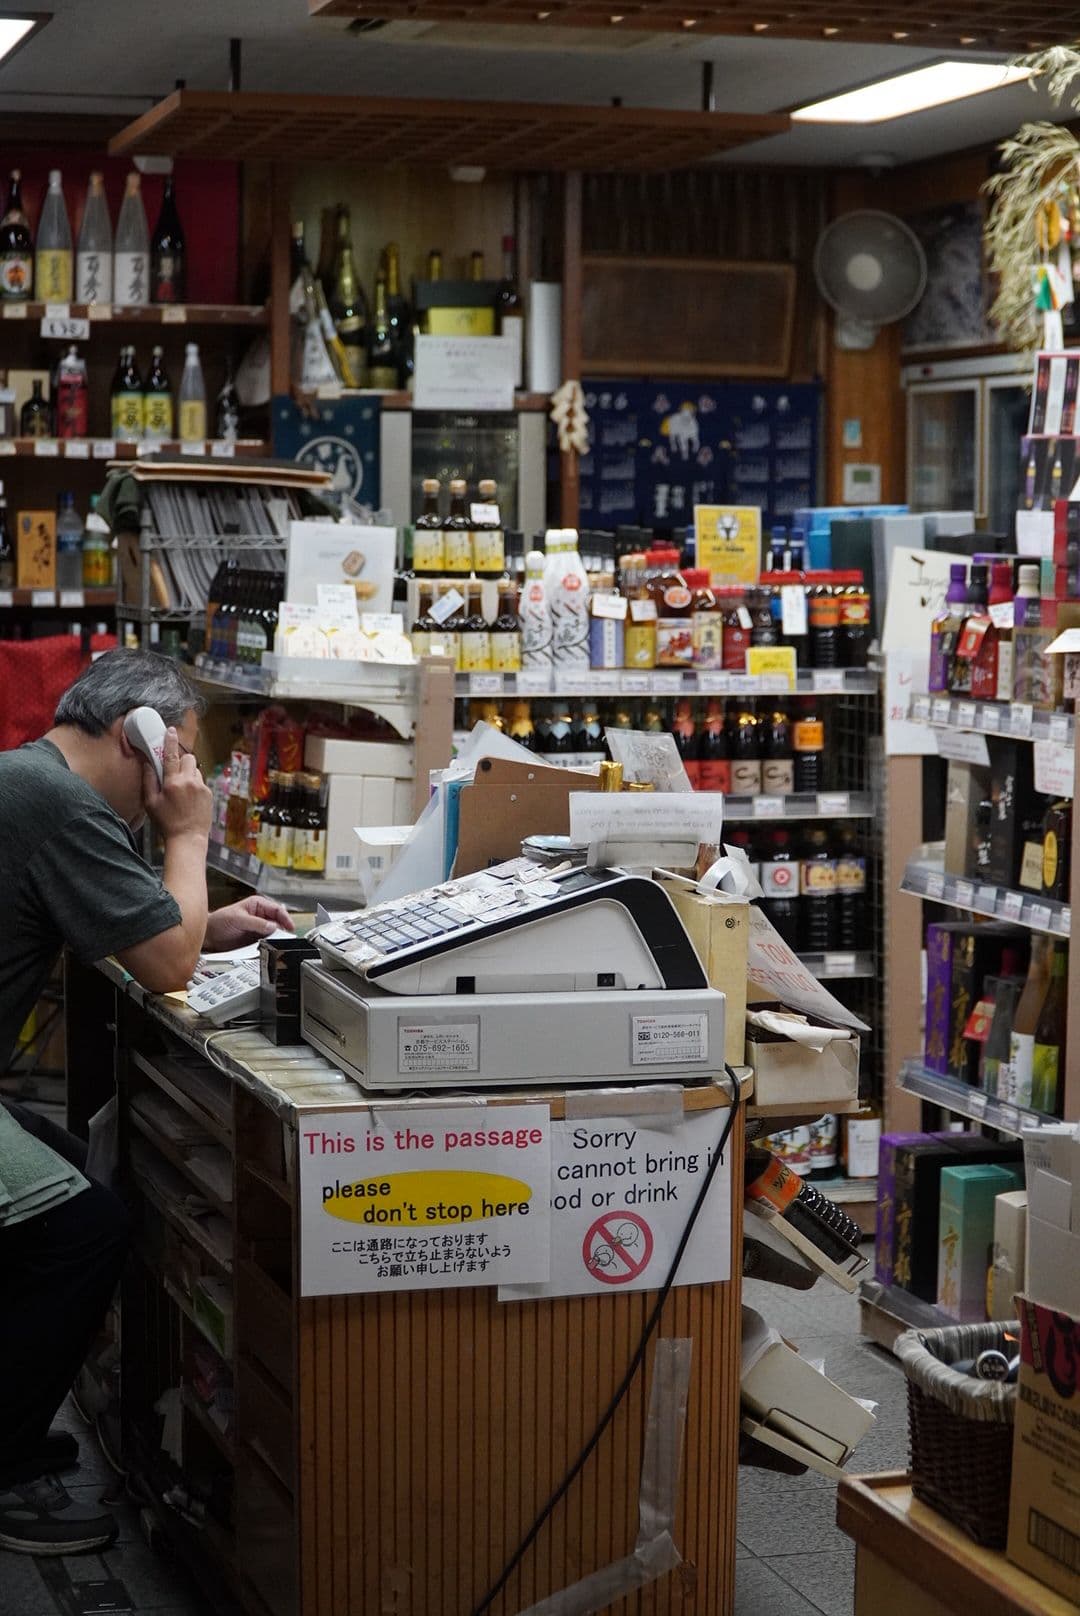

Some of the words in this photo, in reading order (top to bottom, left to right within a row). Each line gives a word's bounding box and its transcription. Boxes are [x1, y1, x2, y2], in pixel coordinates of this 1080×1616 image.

[303, 1131, 356, 1155] This
[365, 1130, 385, 1152] is
[394, 1128, 435, 1151] the
[444, 1127, 543, 1153] passage
[572, 1127, 637, 1150] Sorry
[557, 1156, 636, 1180] cannot
[646, 1150, 699, 1174] bring
[322, 1180, 392, 1204] please
[591, 1191, 615, 1207] or
[624, 1180, 678, 1204] drink
[363, 1199, 418, 1224] don't
[425, 1198, 473, 1224] stop
[481, 1197, 530, 1218] here
[331, 1232, 489, 1253] ここは通路になっております
[358, 1244, 511, 1265] こちらで立ち止まらないよう
[376, 1259, 490, 1278] お願い申し上げます
